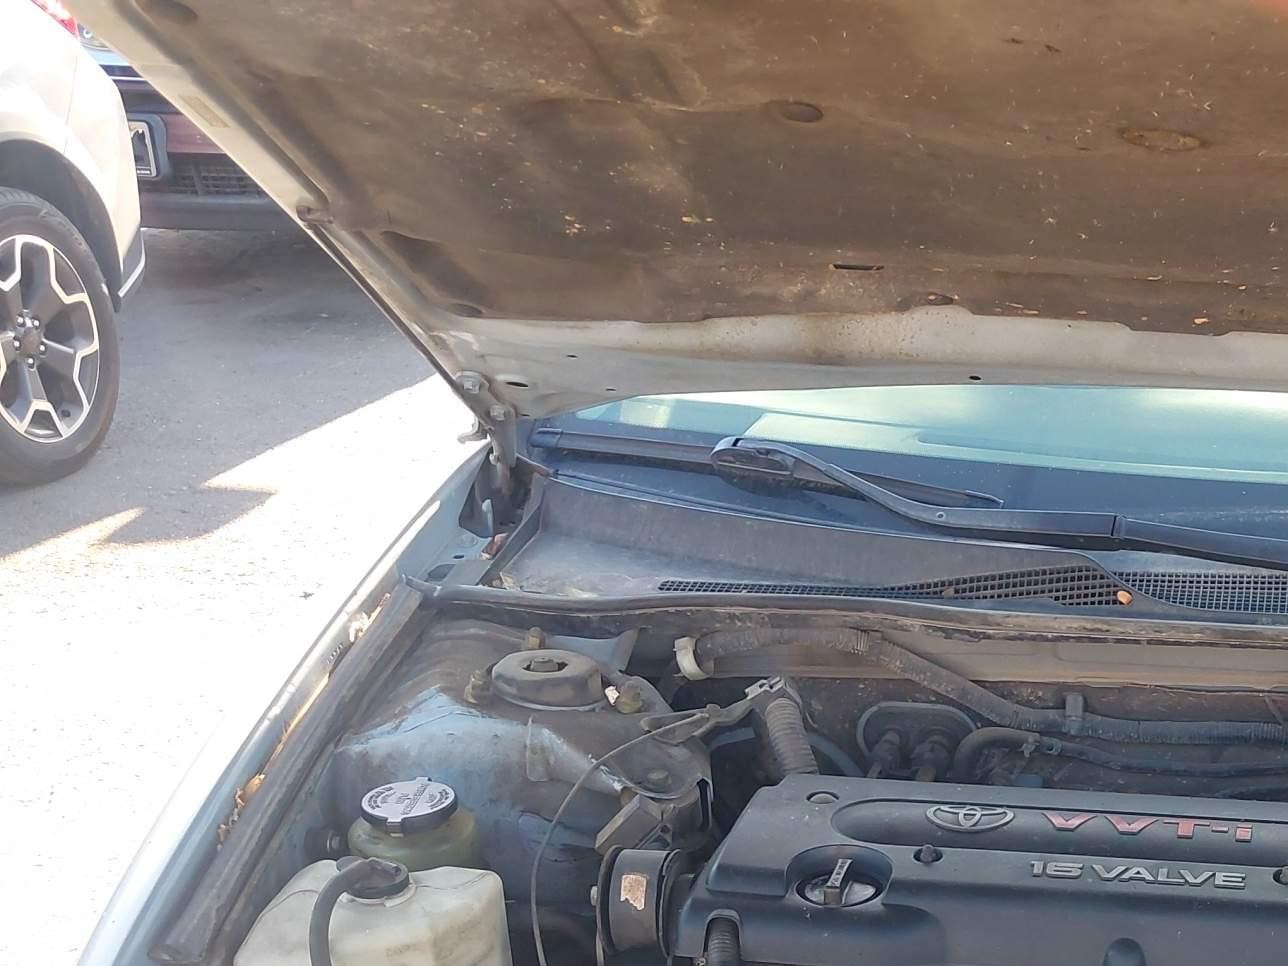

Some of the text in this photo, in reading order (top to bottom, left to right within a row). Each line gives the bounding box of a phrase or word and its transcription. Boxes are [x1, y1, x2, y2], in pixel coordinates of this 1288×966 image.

[1042, 812, 1253, 843] VVT-i
[1030, 860, 1246, 890] 16 VALVE
